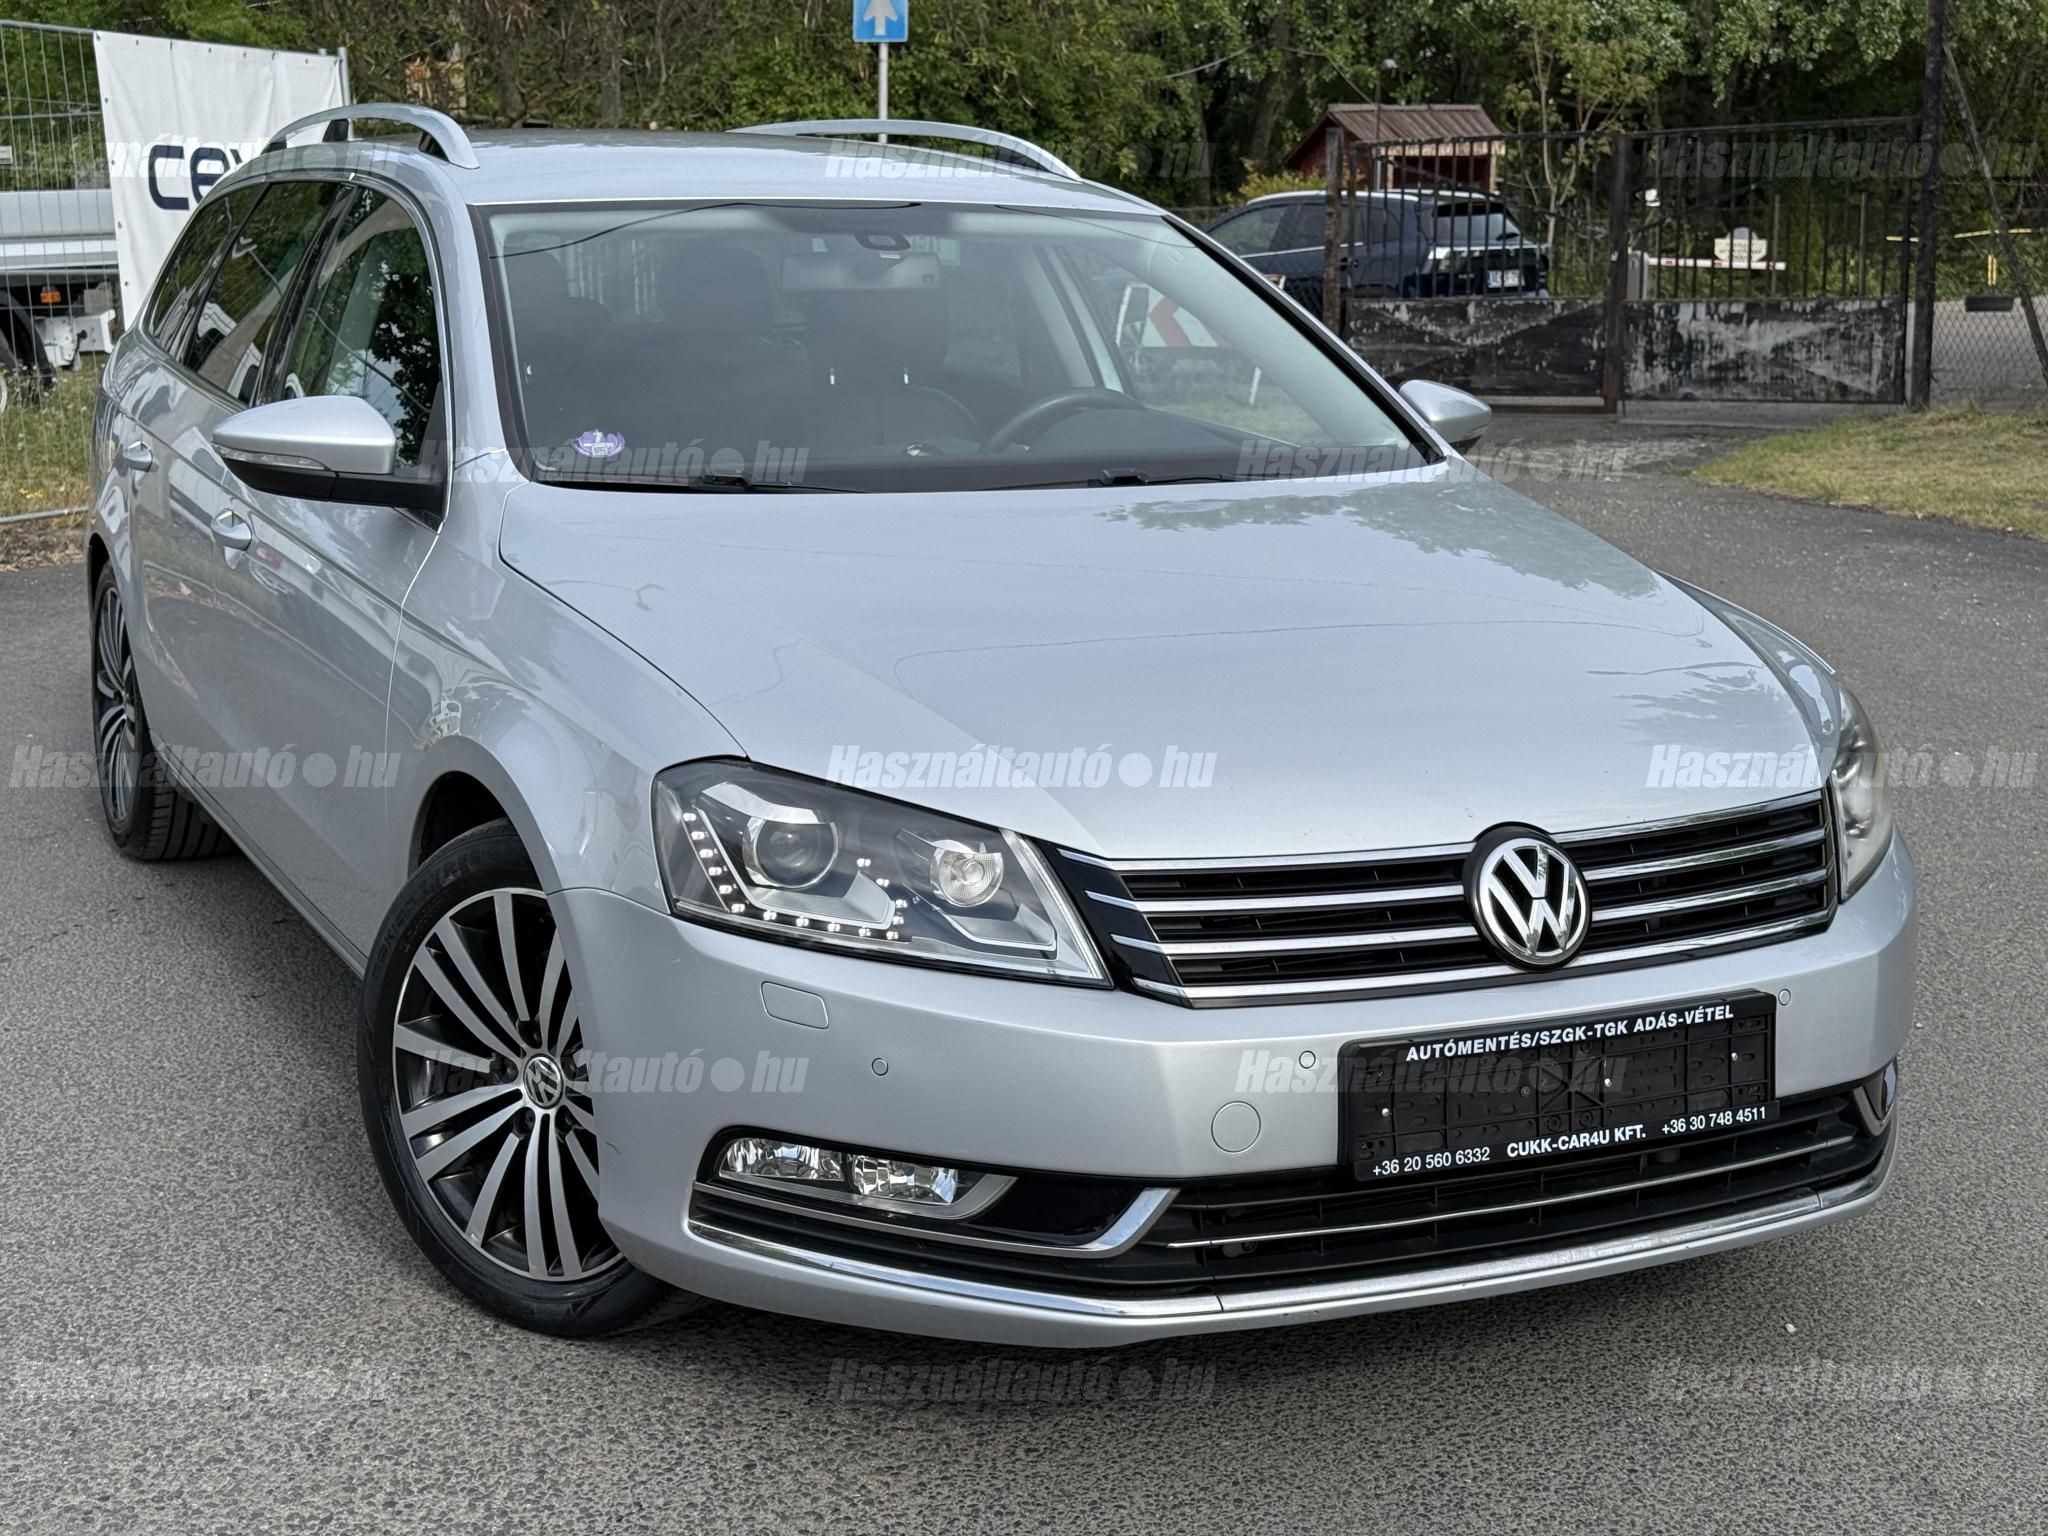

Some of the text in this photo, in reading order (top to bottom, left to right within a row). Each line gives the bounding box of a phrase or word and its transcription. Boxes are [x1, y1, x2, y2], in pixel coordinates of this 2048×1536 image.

[147, 144, 243, 211] ce
[1406, 1005, 1734, 1061] AUTÓMENTÉS/SZGK-TGK ADÁS-VÉTEL
[1373, 1106, 1766, 1176] +36 20 560 6332 CUKK-CAR4U KFT. +36 30 748 4511
